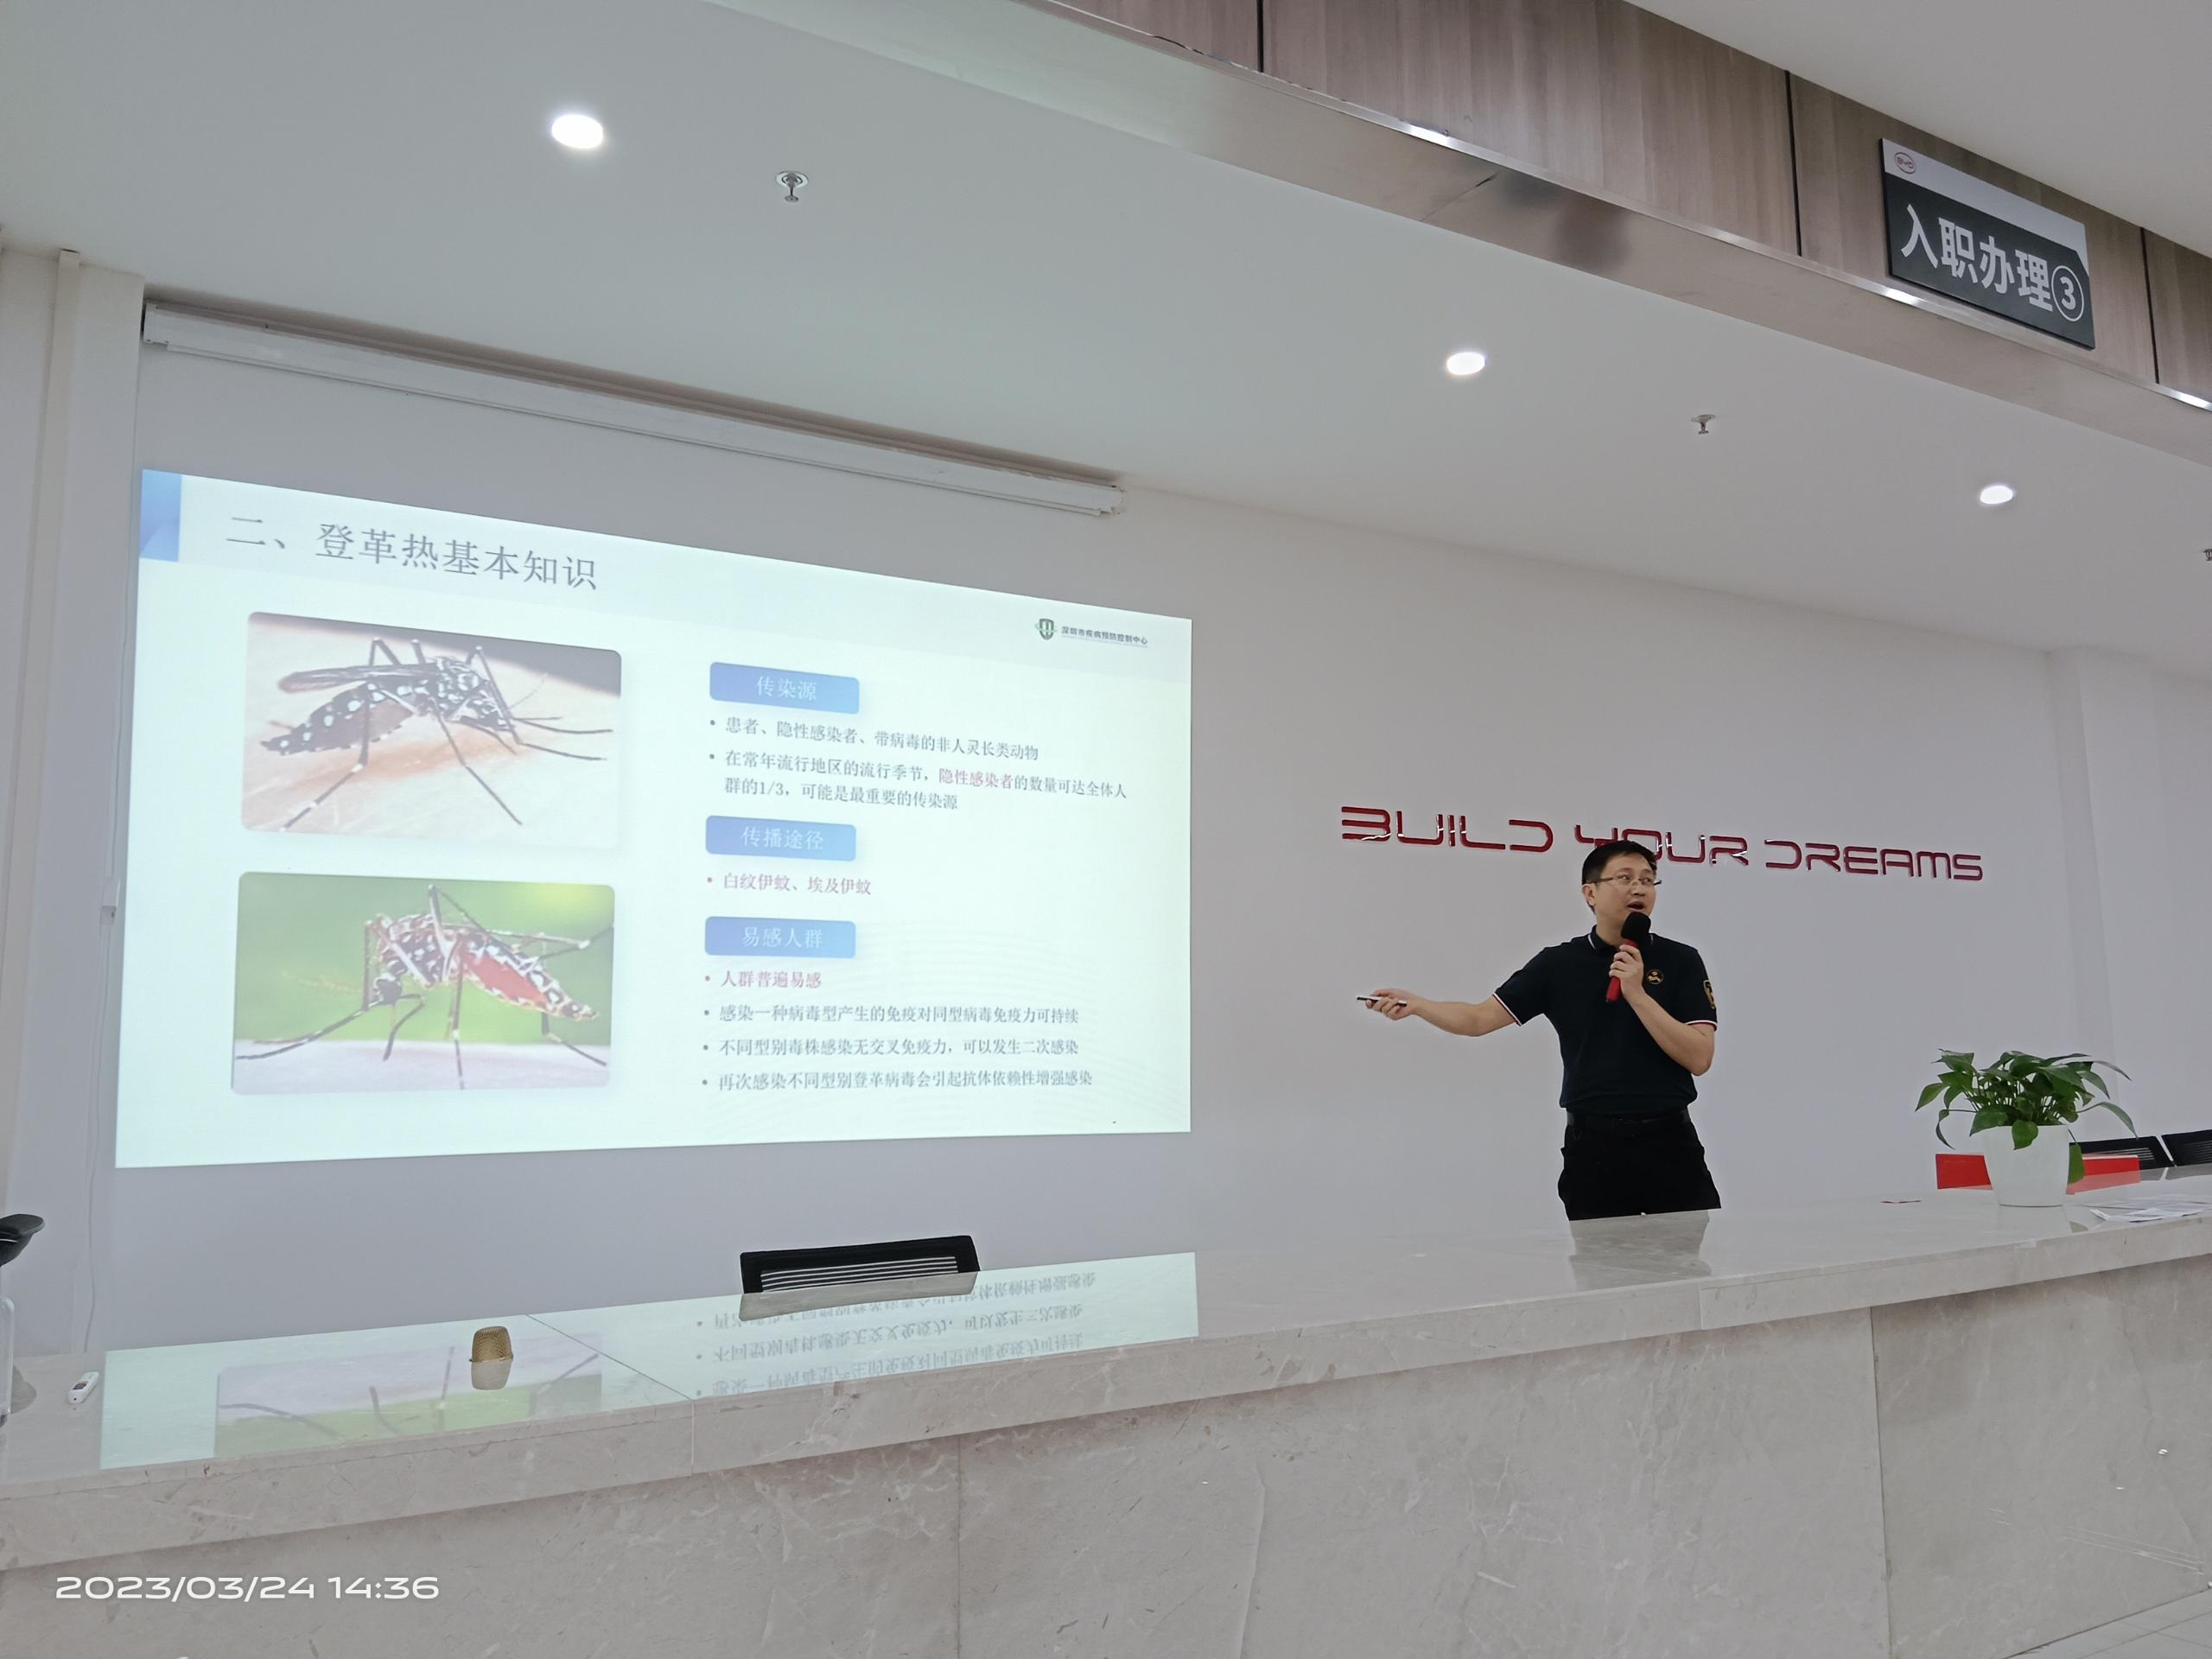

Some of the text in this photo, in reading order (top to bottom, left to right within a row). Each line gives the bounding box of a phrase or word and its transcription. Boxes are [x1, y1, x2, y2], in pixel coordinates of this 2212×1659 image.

[226, 517, 598, 590] 二、登革热基本知识
[756, 675, 817, 702] 传染源
[741, 826, 824, 852] 传播途径
[1341, 806, 1554, 853] BUILD
[1764, 839, 1984, 881] DREAMS
[722, 873, 872, 896] 白纹伊蚊、埃及伊蚊
[741, 925, 823, 950] 易感人群
[721, 970, 822, 988] 人群普遍易感
